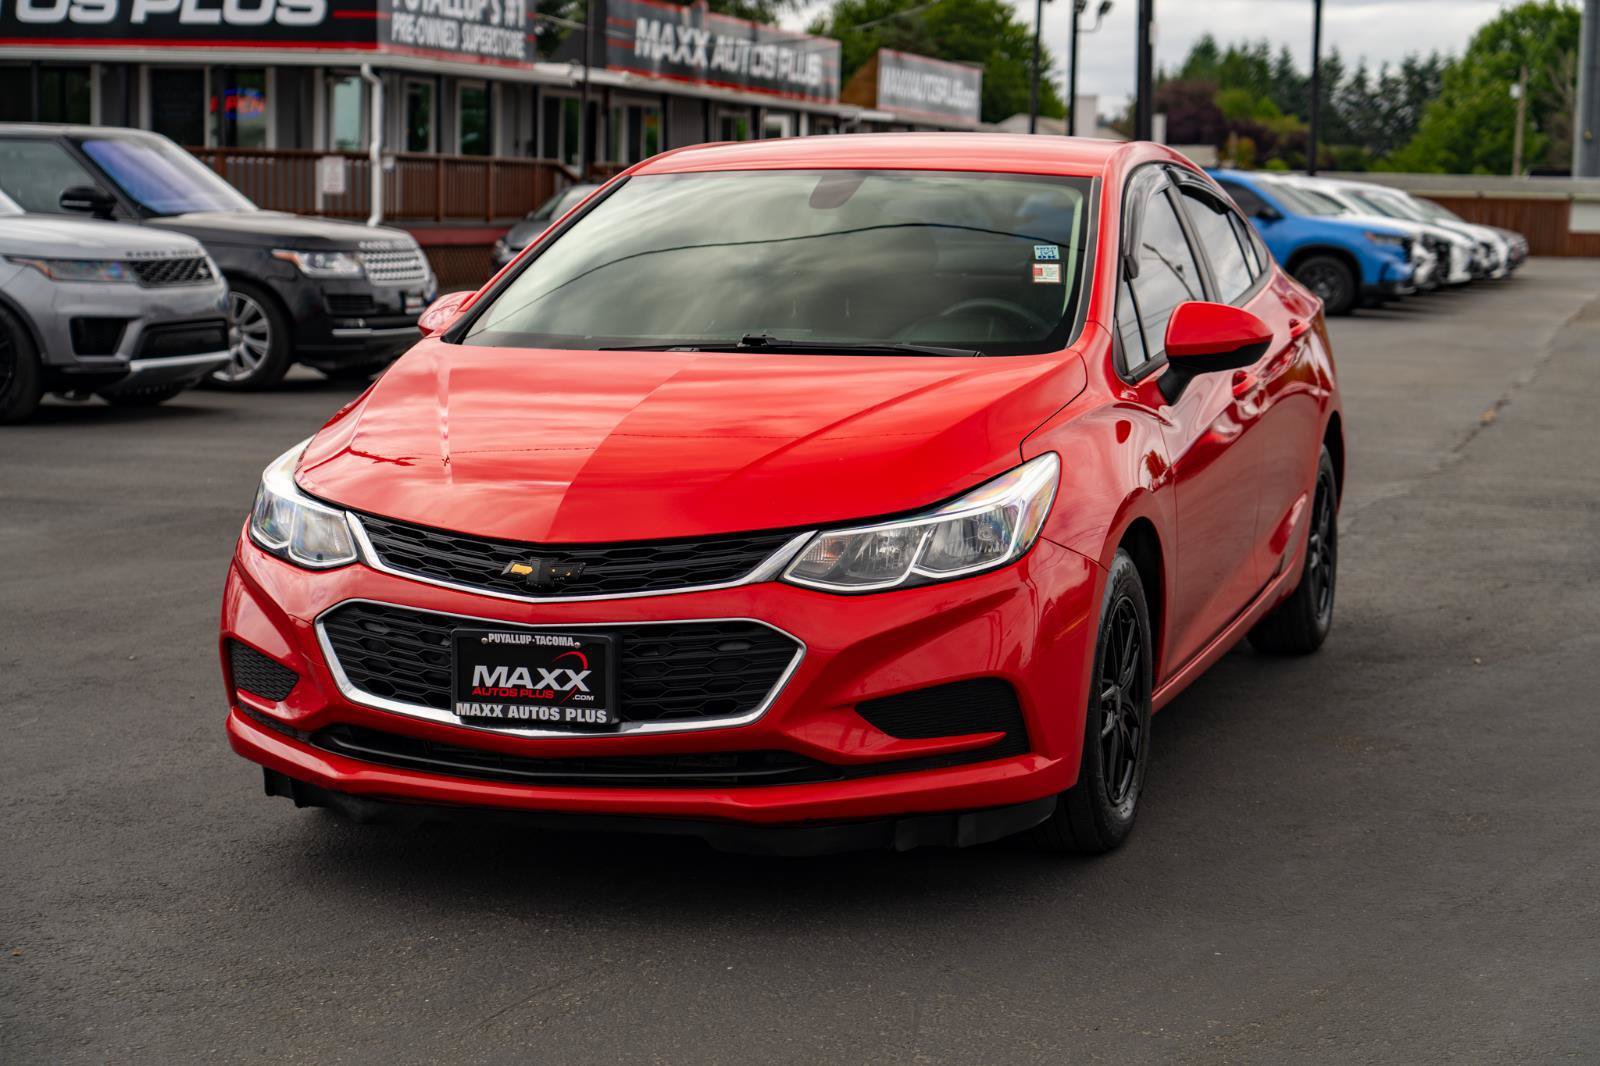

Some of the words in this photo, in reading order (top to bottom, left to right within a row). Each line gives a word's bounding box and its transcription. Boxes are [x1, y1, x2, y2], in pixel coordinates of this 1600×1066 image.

[391, 12, 459, 48] PRE-OWNED
[634, 17, 709, 69] MAXX
[710, 35, 778, 79] AUTOS
[777, 47, 823, 86] PLUS
[472, 665, 592, 692] MAXX
[472, 687, 518, 697] AUTOS
[519, 689, 555, 699] PLUS
[456, 703, 503, 718] MAXX
[508, 706, 560, 721] AUTOS
[565, 708, 608, 724] PLUS
